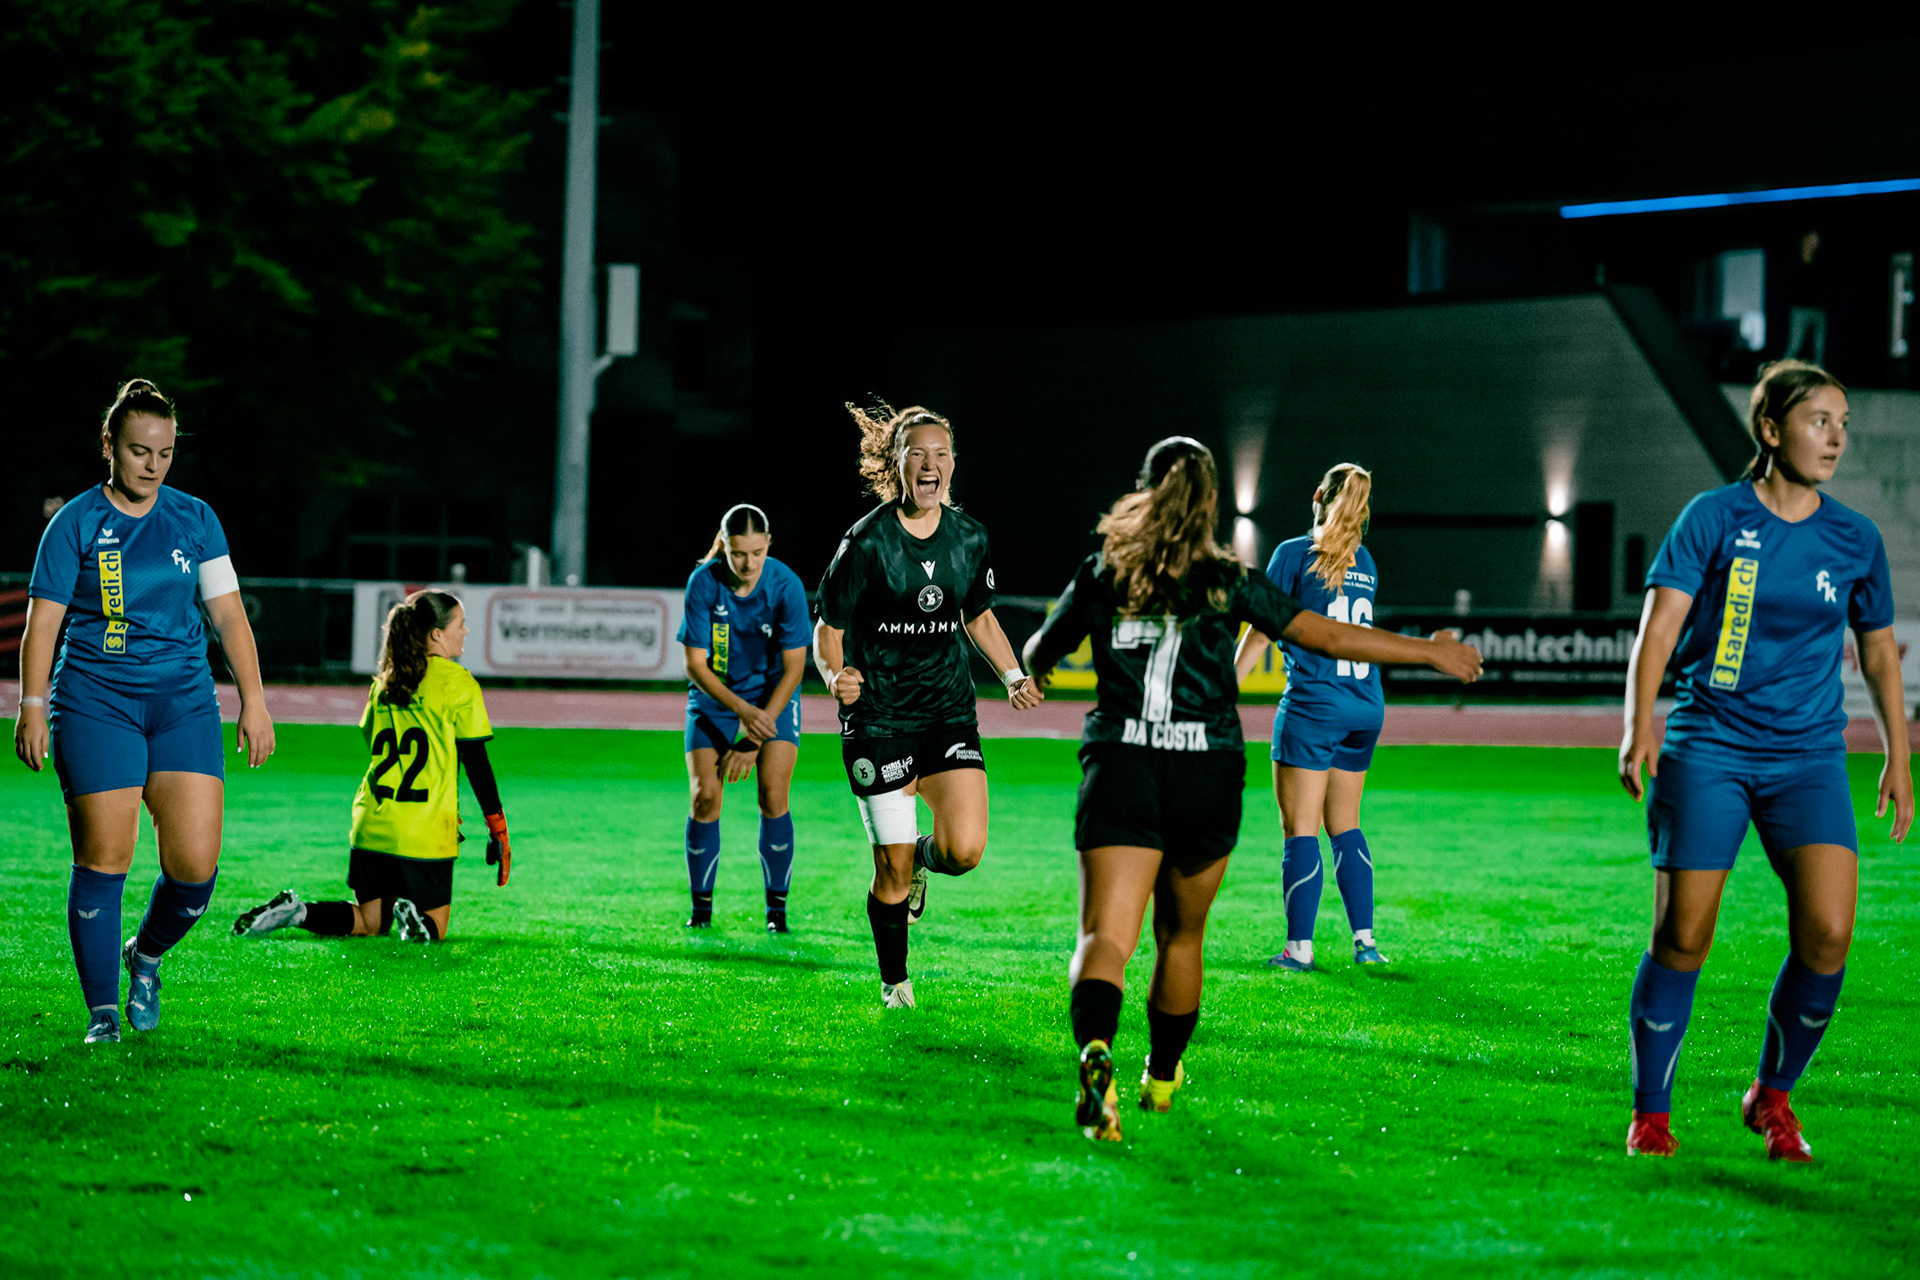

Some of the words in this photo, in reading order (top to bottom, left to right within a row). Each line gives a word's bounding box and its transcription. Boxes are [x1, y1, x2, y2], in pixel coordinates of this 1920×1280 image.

[101, 552, 126, 631] sredi.ch
[1725, 561, 1755, 664] saredi.ch
[1111, 615, 1182, 724] 7
[1327, 595, 1374, 680] 16
[1431, 626, 1638, 663] ahntechni
[371, 726, 429, 804] 22
[881, 759, 902, 773] CHRIS
[1121, 718, 1148, 746] DA
[1151, 721, 1209, 752] COSTA
